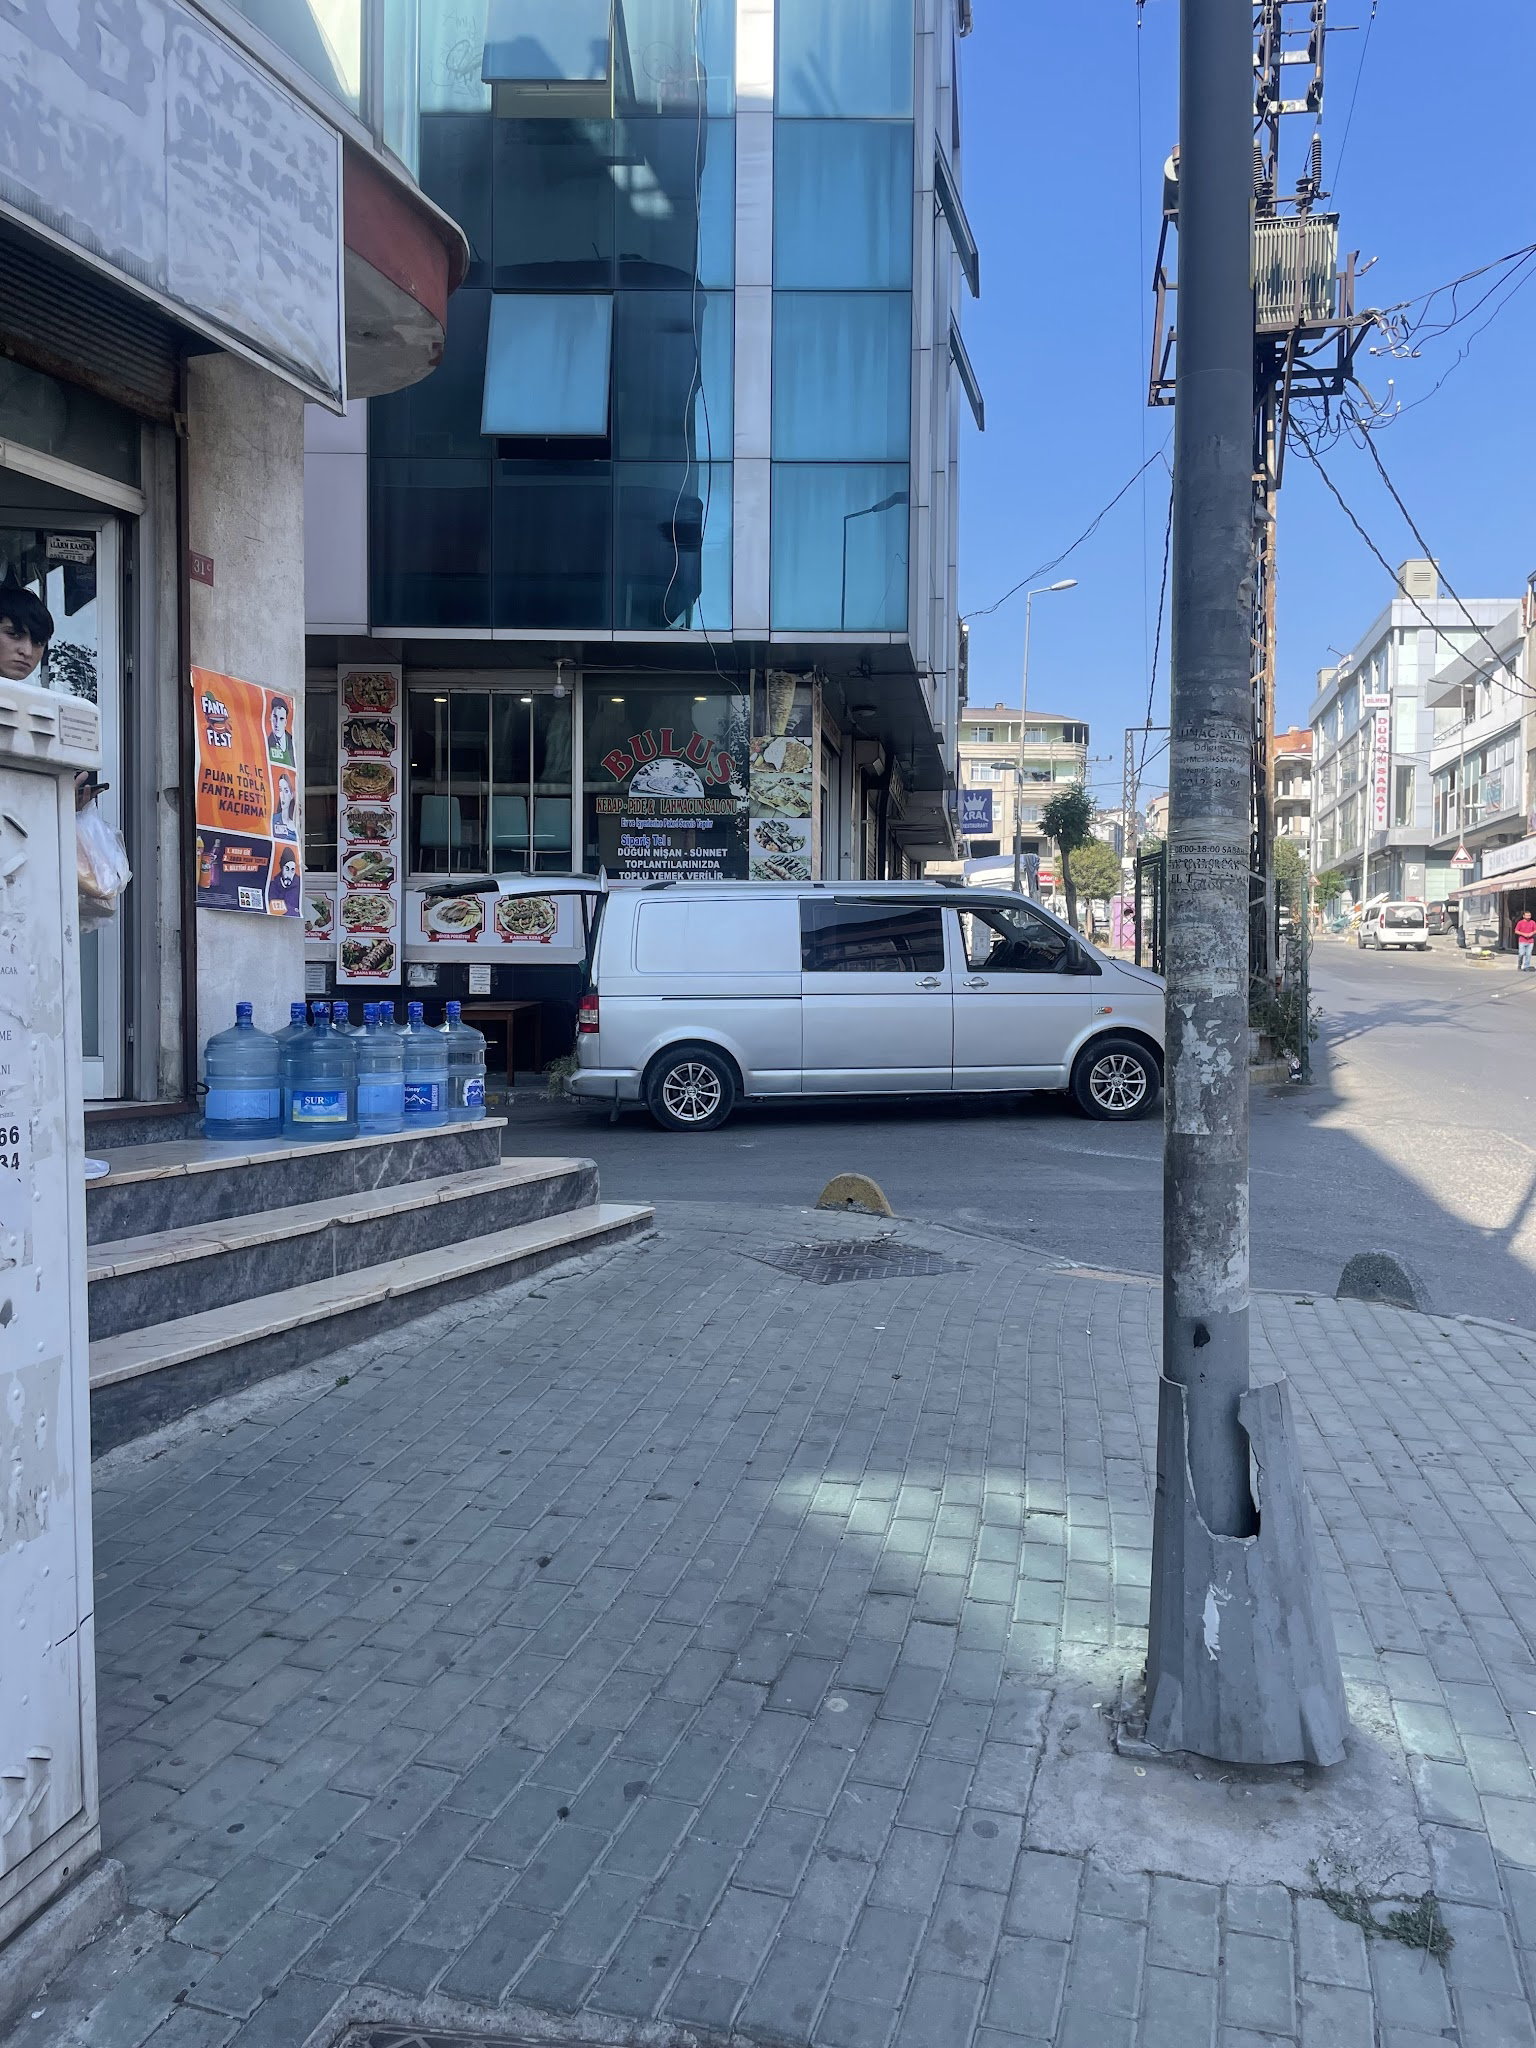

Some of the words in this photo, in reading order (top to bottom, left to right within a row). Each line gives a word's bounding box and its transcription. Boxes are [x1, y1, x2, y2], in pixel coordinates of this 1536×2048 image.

[201, 696, 228, 718] FANTA
[206, 729, 232, 749] FEST
[204, 768, 233, 785] PUAN
[237, 775, 266, 793] TOPLA
[201, 782, 235, 799] FANTA
[1376, 767, 1387, 822] SARAYI
[596, 798, 623, 815] KEBAP
[705, 799, 738, 815] SALONU
[963, 811, 989, 822] KRAL
[621, 834, 650, 848] Sipariş
[618, 848, 650, 857] DÜĞÜN
[653, 848, 682, 859] NİŞAN
[690, 848, 729, 857] SÜNNET
[625, 860, 721, 868] TOPLANTILARINIZDA
[619, 872, 649, 880] TOPLU
[651, 872, 685, 880] YEMEK
